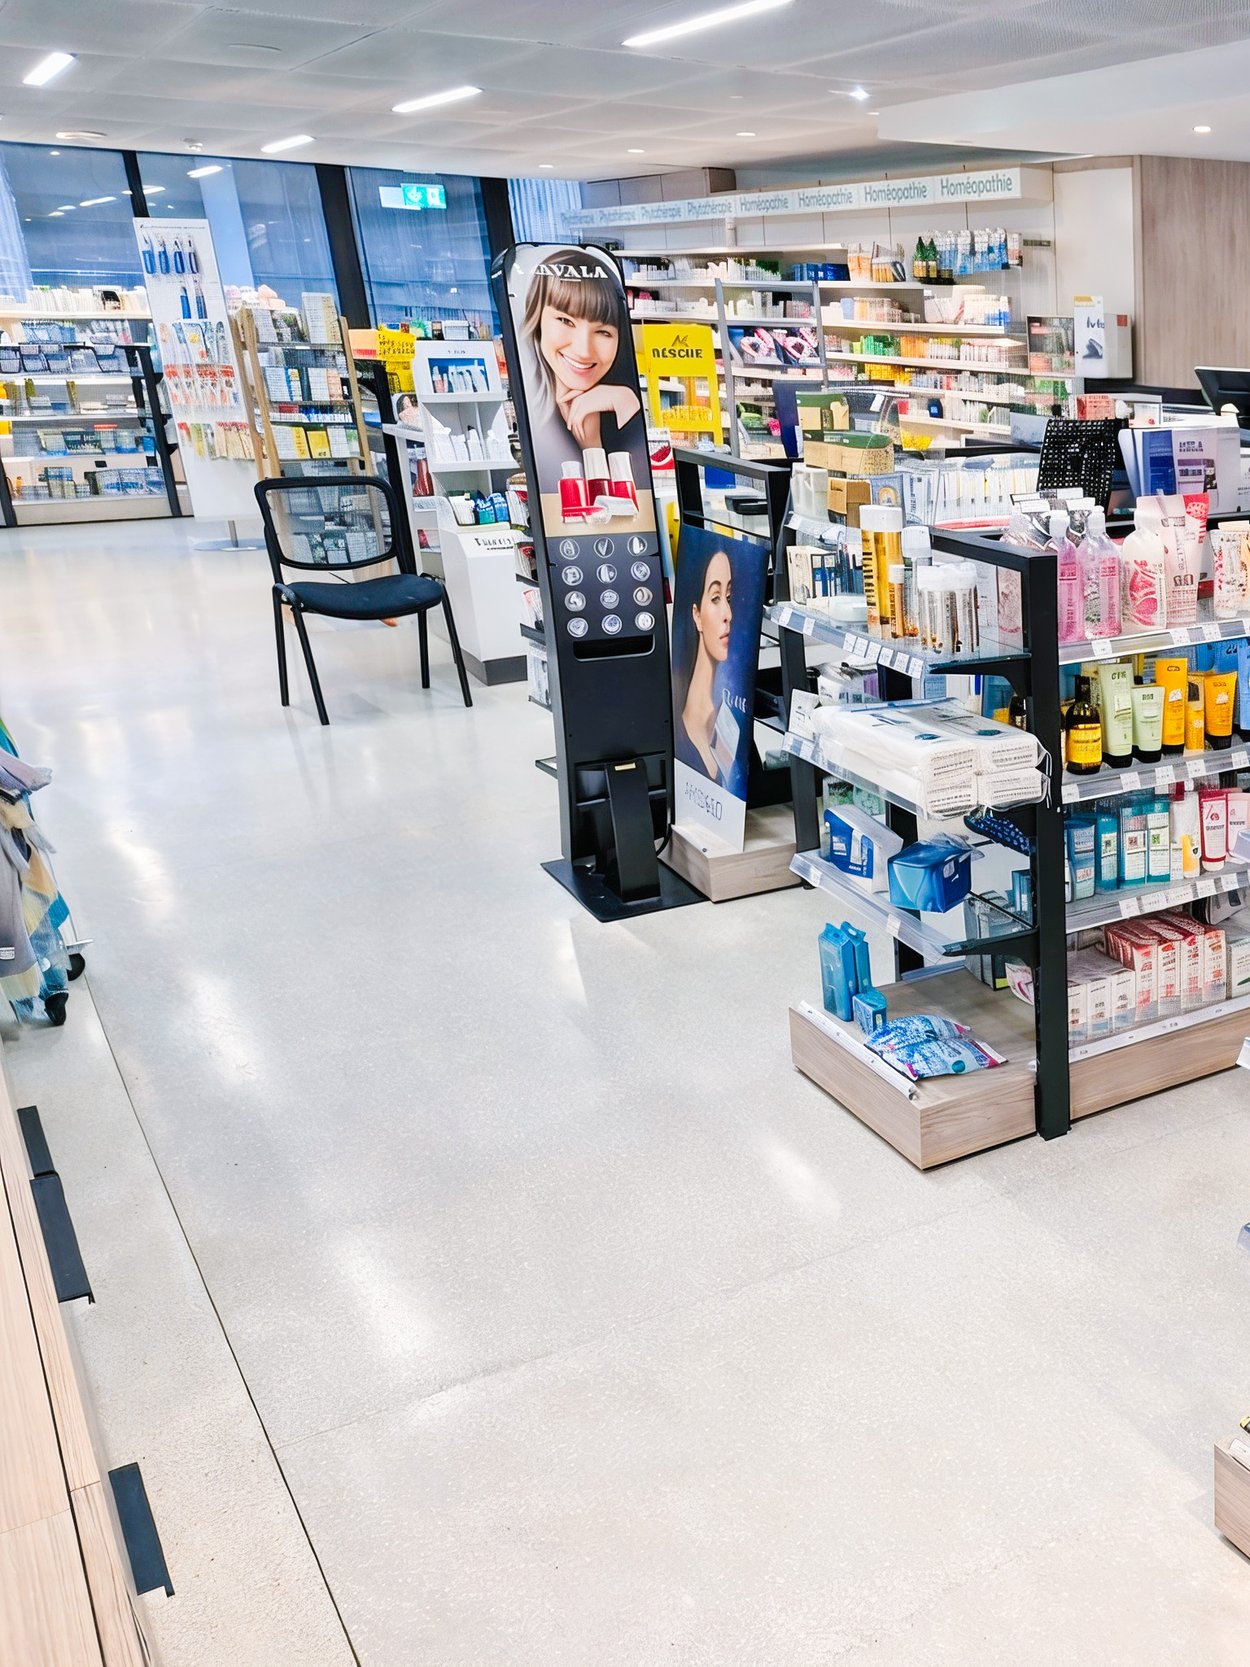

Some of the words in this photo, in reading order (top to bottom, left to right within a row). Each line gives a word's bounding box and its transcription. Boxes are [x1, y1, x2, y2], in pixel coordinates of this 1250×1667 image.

[798, 186, 853, 208] Homéopathie
[864, 180, 928, 204] Homéopathie
[940, 173, 1013, 198] Homéopathie
